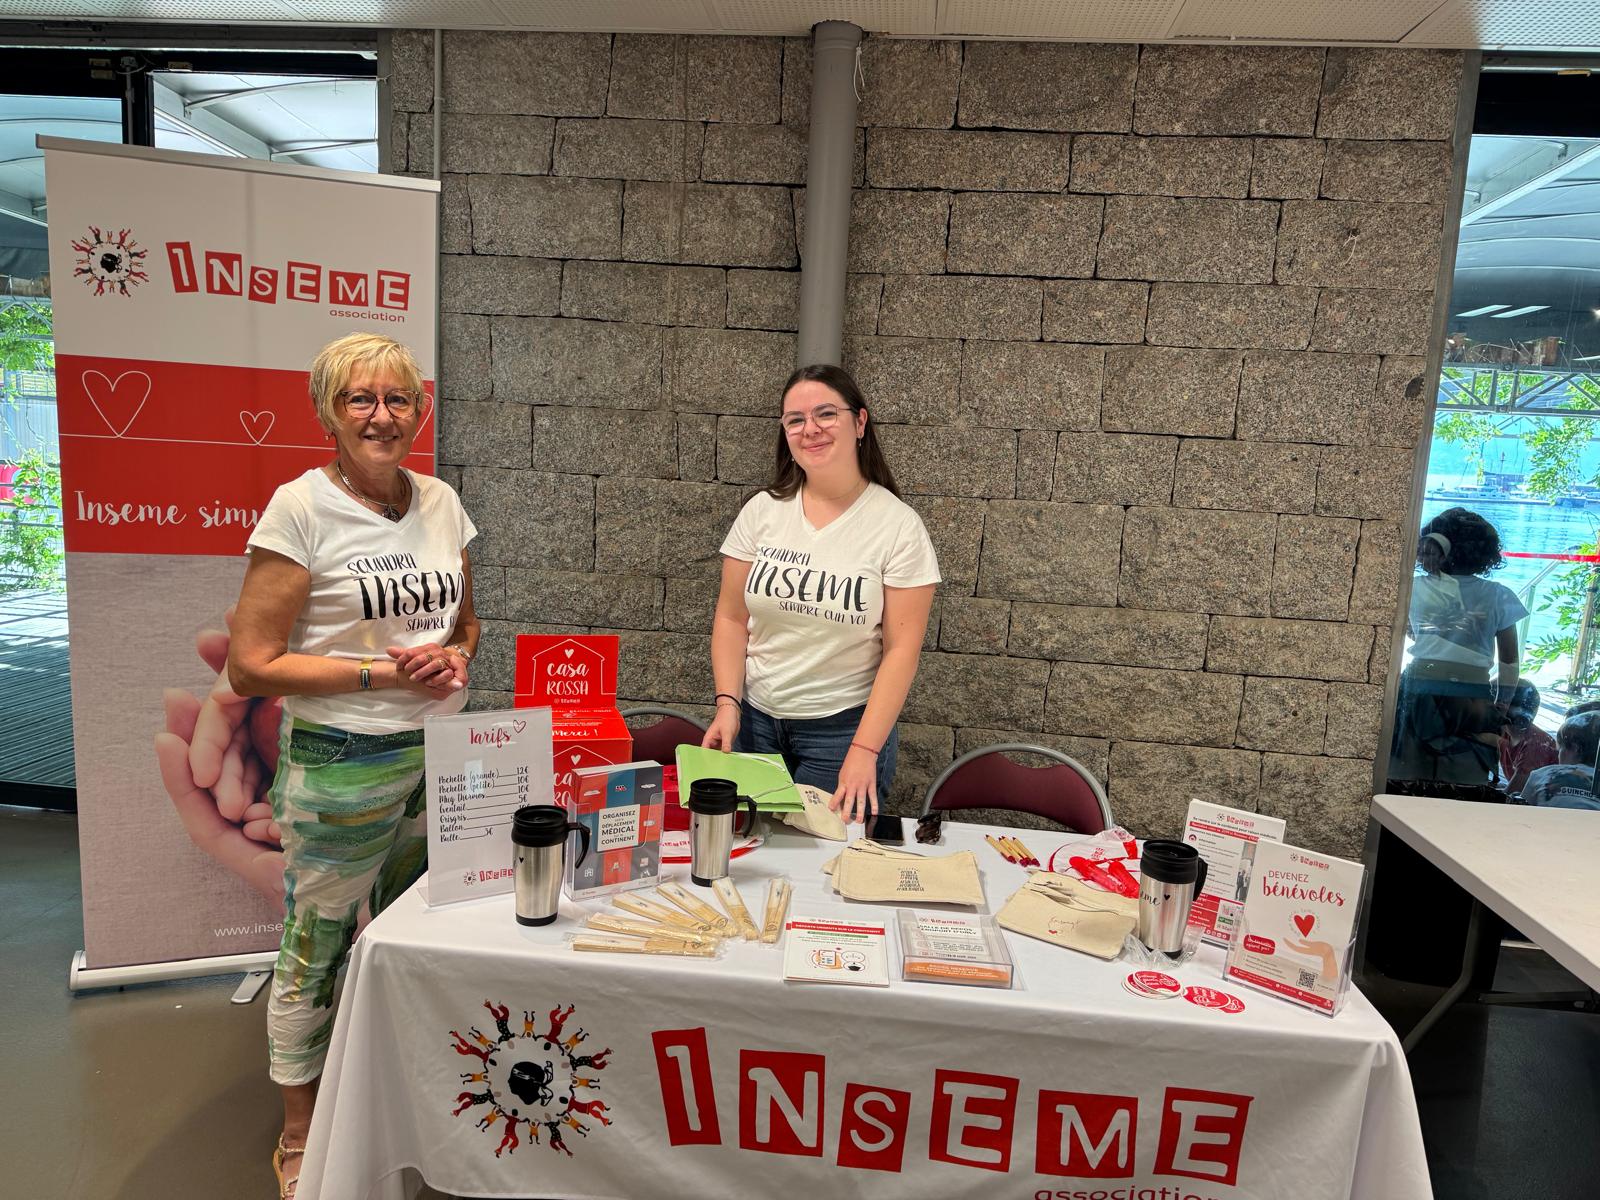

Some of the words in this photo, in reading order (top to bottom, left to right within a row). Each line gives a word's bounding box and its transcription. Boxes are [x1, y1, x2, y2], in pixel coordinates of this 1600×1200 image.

[168, 244, 409, 310] INSEME
[329, 307, 405, 323] association
[74, 490, 187, 525] Inseme
[346, 552, 417, 575] SQUADRA
[747, 559, 869, 611] INSEME
[779, 601, 820, 617] SEMPRE
[850, 614, 867, 625] VOI
[405, 616, 446, 632] SEMPRE
[546, 680, 589, 695] ROSSA
[468, 728, 511, 748] Tarifs
[517, 766, 529, 775] 12€
[469, 779, 495, 793] (petite)
[517, 775, 529, 784] 10€
[439, 795, 454, 806] Mug
[457, 793, 485, 802] thermos
[518, 784, 529, 793] 10€
[518, 794, 528, 803] 5€
[602, 810, 636, 820] ORGANISEZ
[601, 836, 634, 845] CONTINENT
[1268, 870, 1309, 883] DEVENEZ
[1263, 875, 1346, 907] bénévoles
[658, 1035, 1246, 1182] INSEME
[1034, 1185, 1220, 1200] associati
